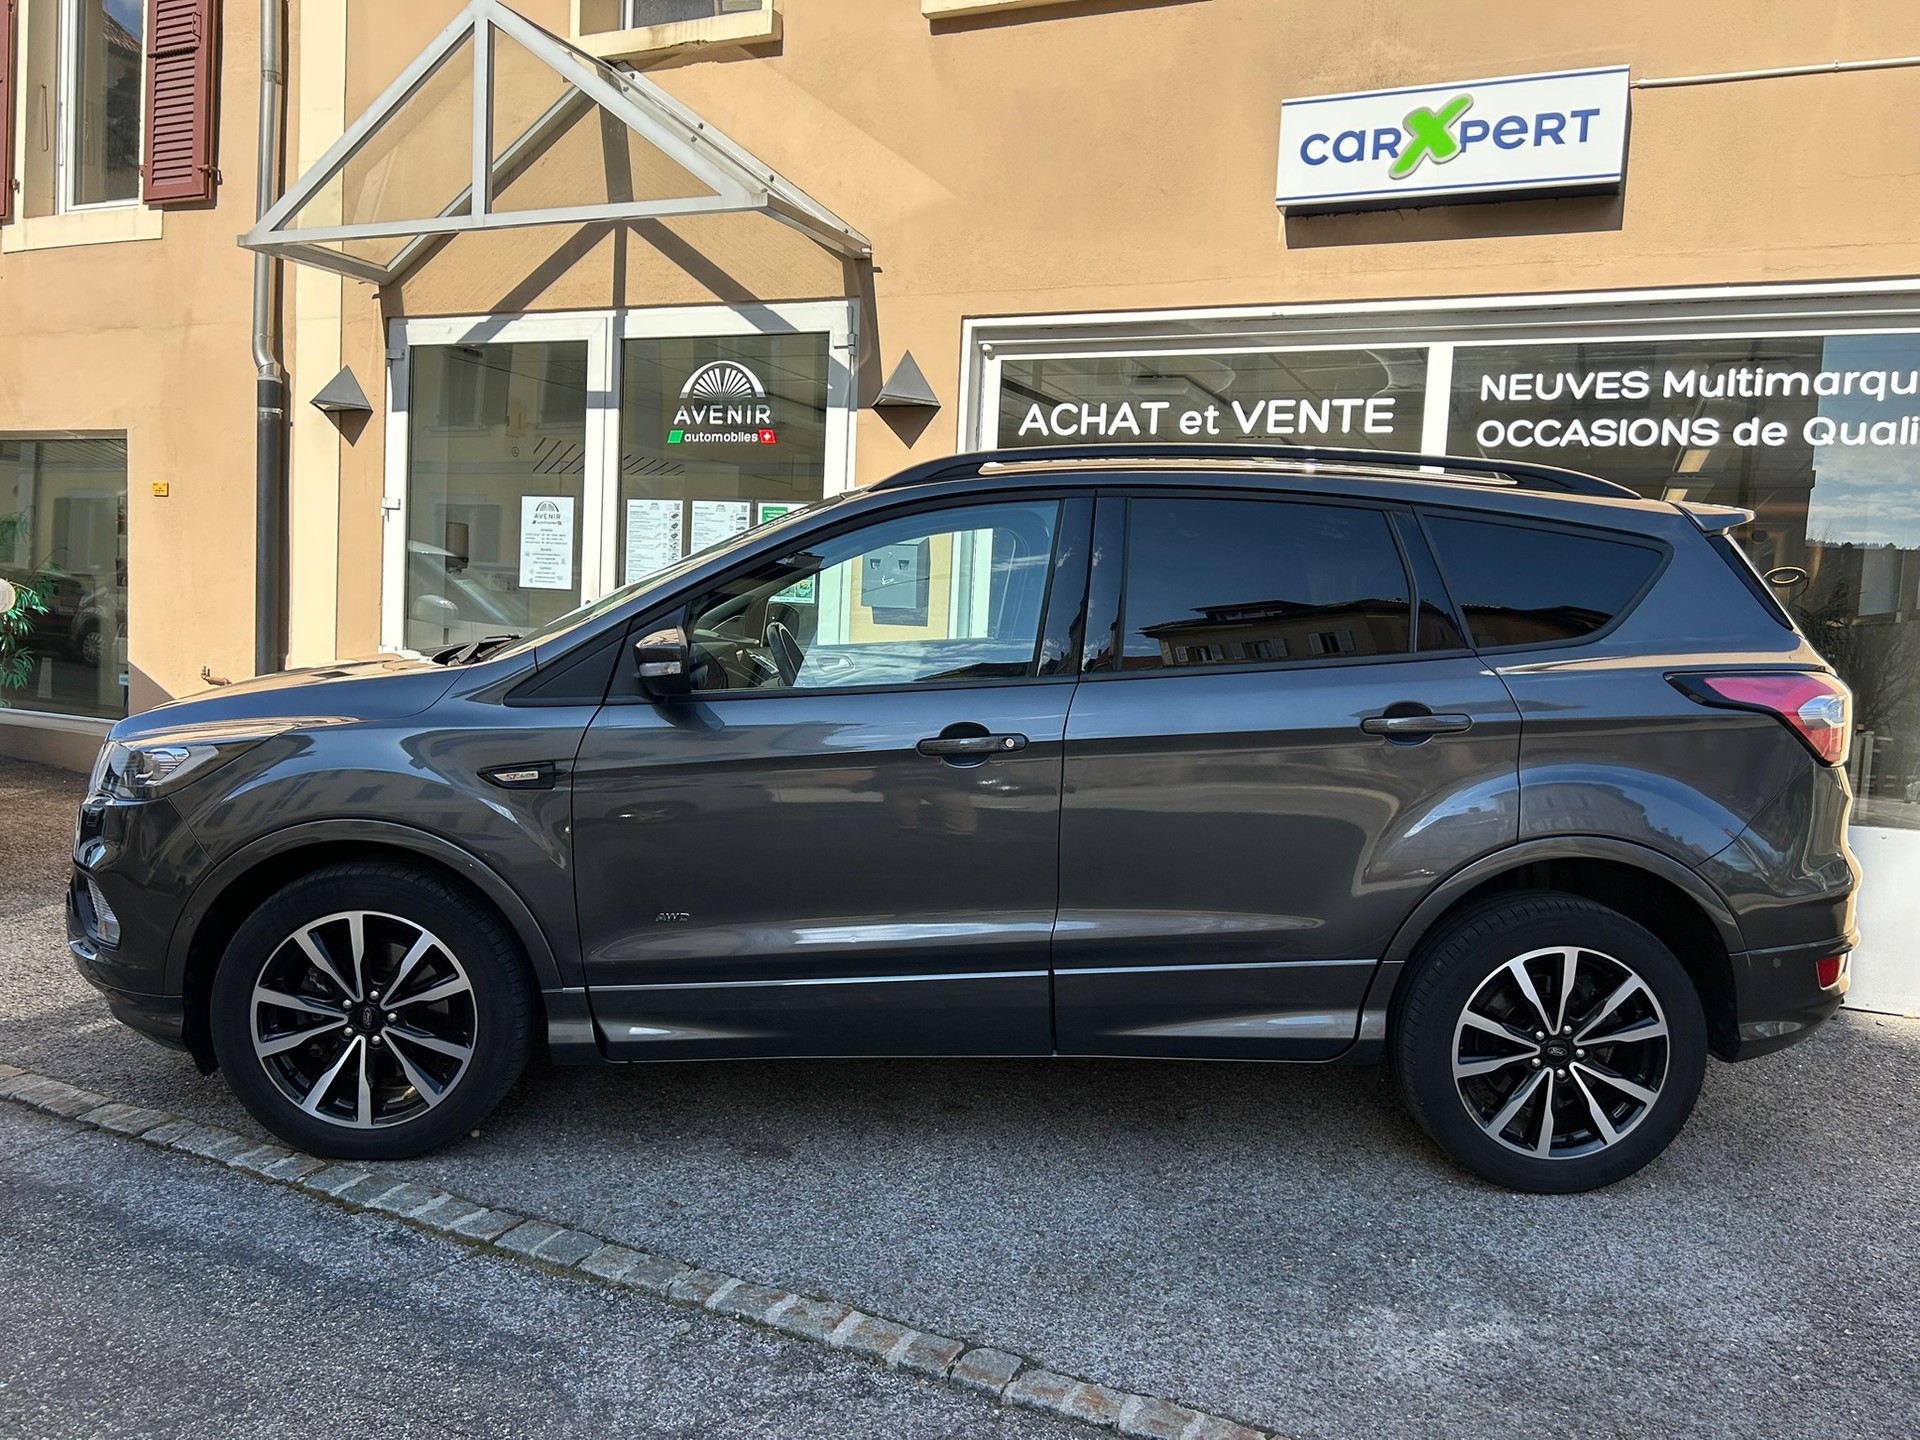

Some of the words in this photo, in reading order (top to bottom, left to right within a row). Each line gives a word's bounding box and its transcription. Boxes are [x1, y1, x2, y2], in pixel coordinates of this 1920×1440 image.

[1480, 370, 1650, 401] NEUVES
[1663, 367, 1919, 402] Multimarqu
[673, 404, 771, 425] AVENIR
[1018, 401, 1170, 436] ACHAT
[1179, 405, 1220, 435] et
[1231, 397, 1396, 434] VENTE
[684, 431, 759, 442] automobiles
[1476, 417, 1720, 448] OCCASIONS
[1732, 417, 1788, 447] de
[1803, 415, 1920, 446] Quali
[655, 912, 690, 922] AWD
